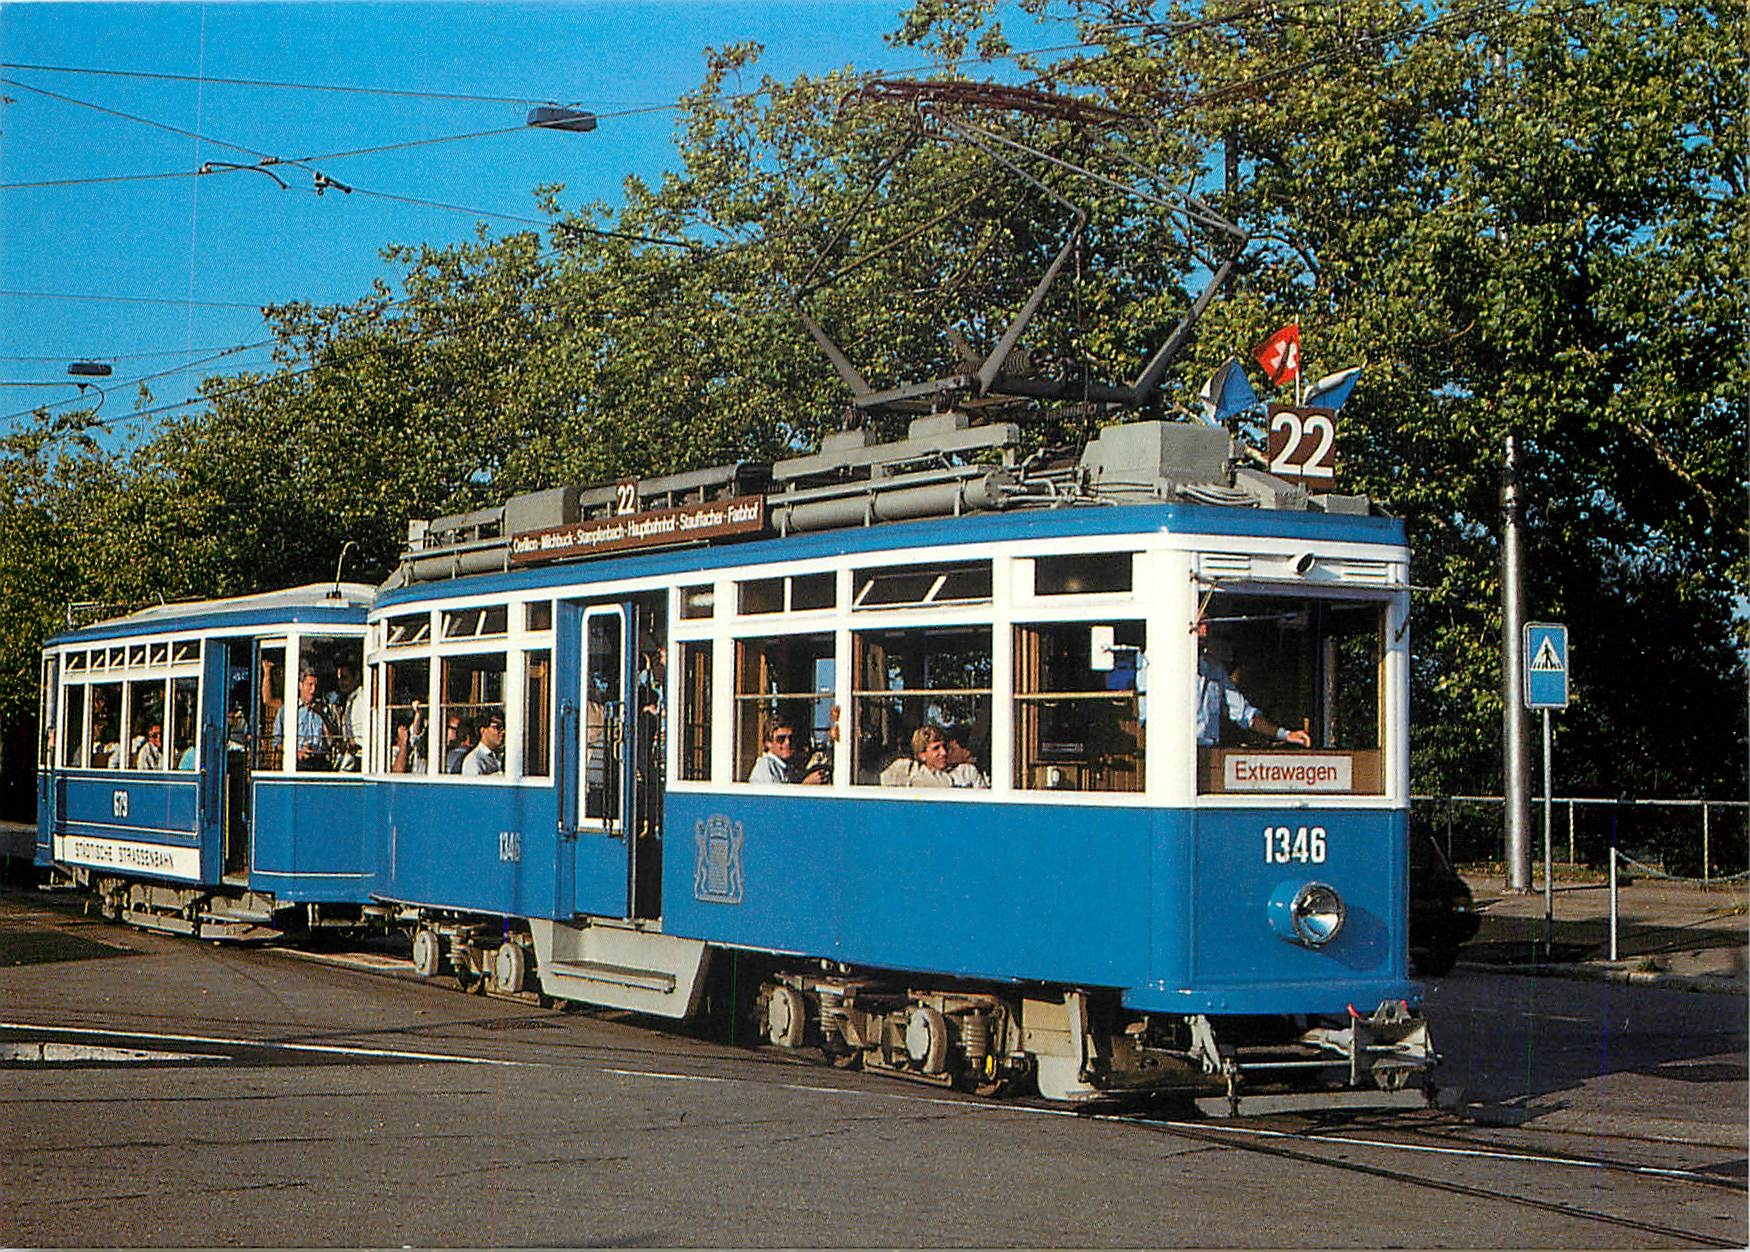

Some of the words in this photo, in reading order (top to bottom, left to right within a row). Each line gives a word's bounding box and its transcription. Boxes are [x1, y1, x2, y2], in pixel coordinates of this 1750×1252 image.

[1271, 411, 1334, 478] 22
[617, 484, 635, 516] 22
[541, 530, 574, 550] Milchbuck
[628, 515, 676, 540] Hauptbahnhof
[680, 508, 723, 531] Stauffacher
[728, 501, 759, 524] Farbhof
[1235, 760, 1338, 785] Extrawagen
[118, 846, 174, 869] STRASSENBAHN
[499, 831, 521, 862] 1346
[1263, 826, 1327, 864] 1346
